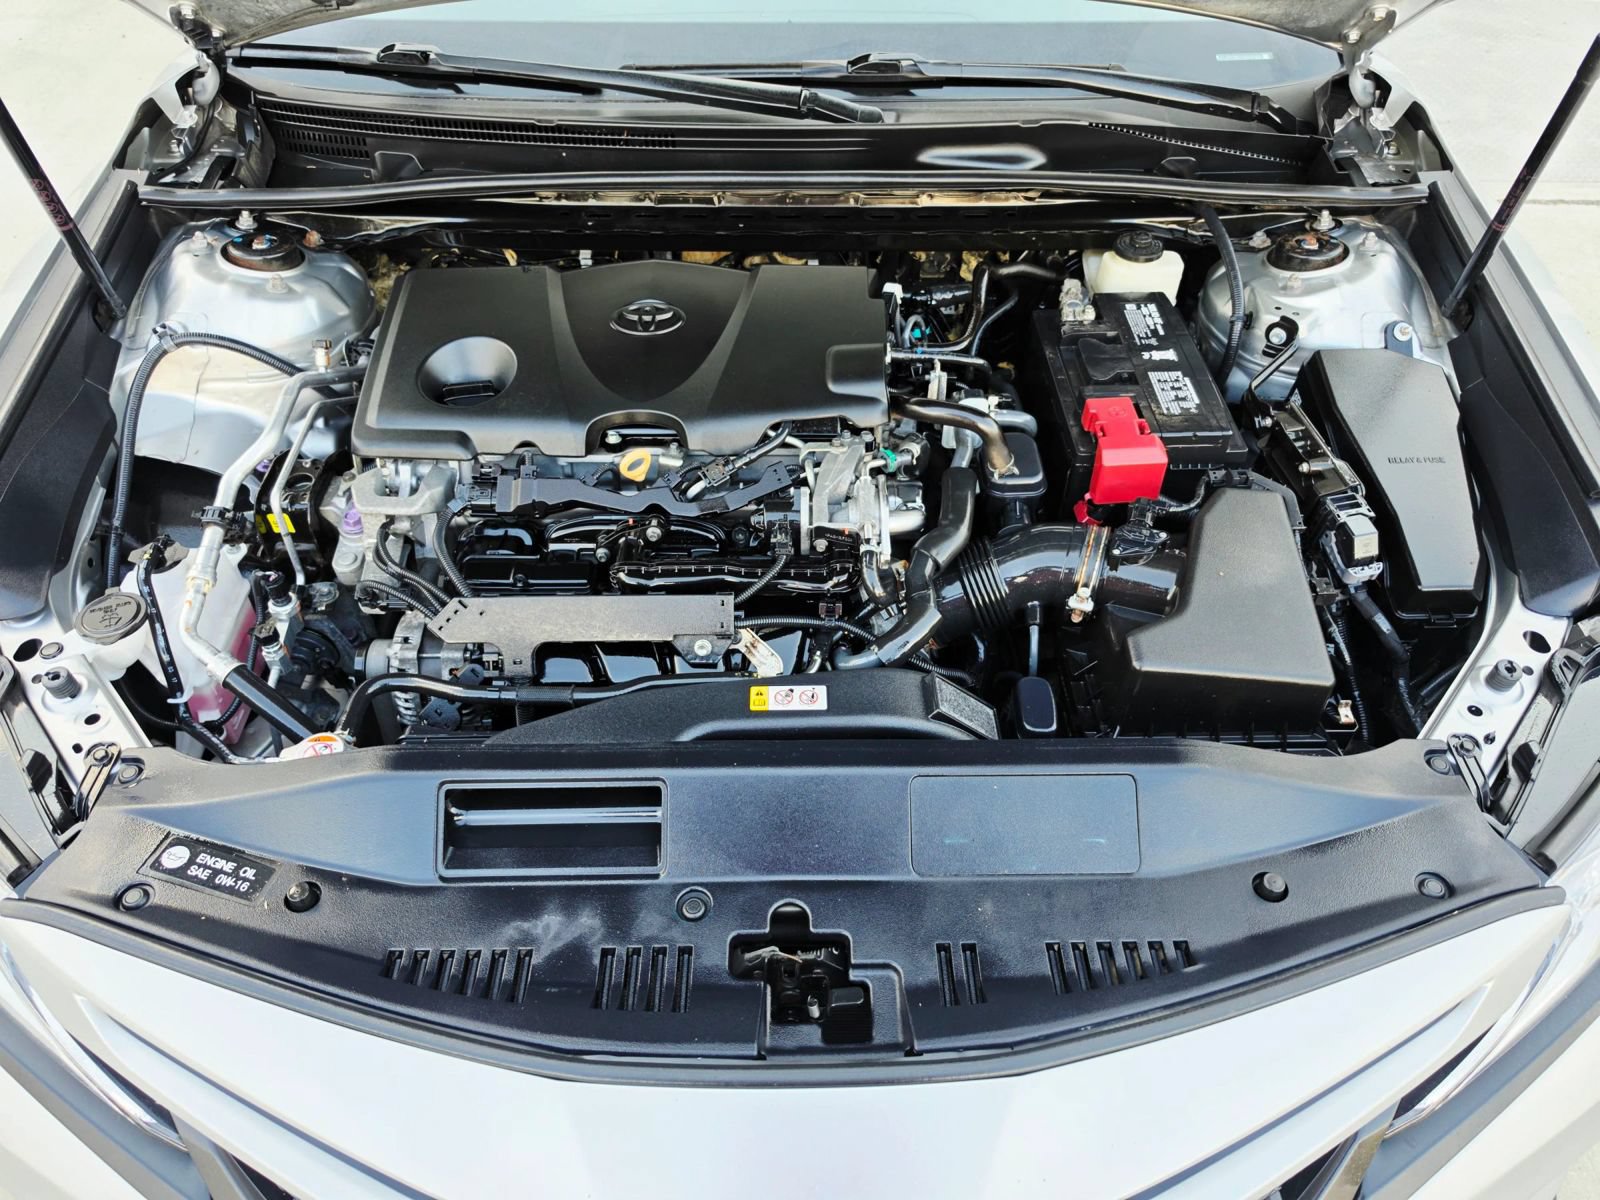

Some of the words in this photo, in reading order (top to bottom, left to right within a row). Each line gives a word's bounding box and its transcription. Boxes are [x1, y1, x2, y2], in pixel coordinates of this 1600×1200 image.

[1387, 456, 1414, 464] RELAY
[1423, 456, 1446, 464] FUSE
[187, 865, 212, 880] SAE
[215, 874, 250, 892] 0W-16
[195, 853, 237, 873] ENGINE
[239, 866, 256, 880] OIL
